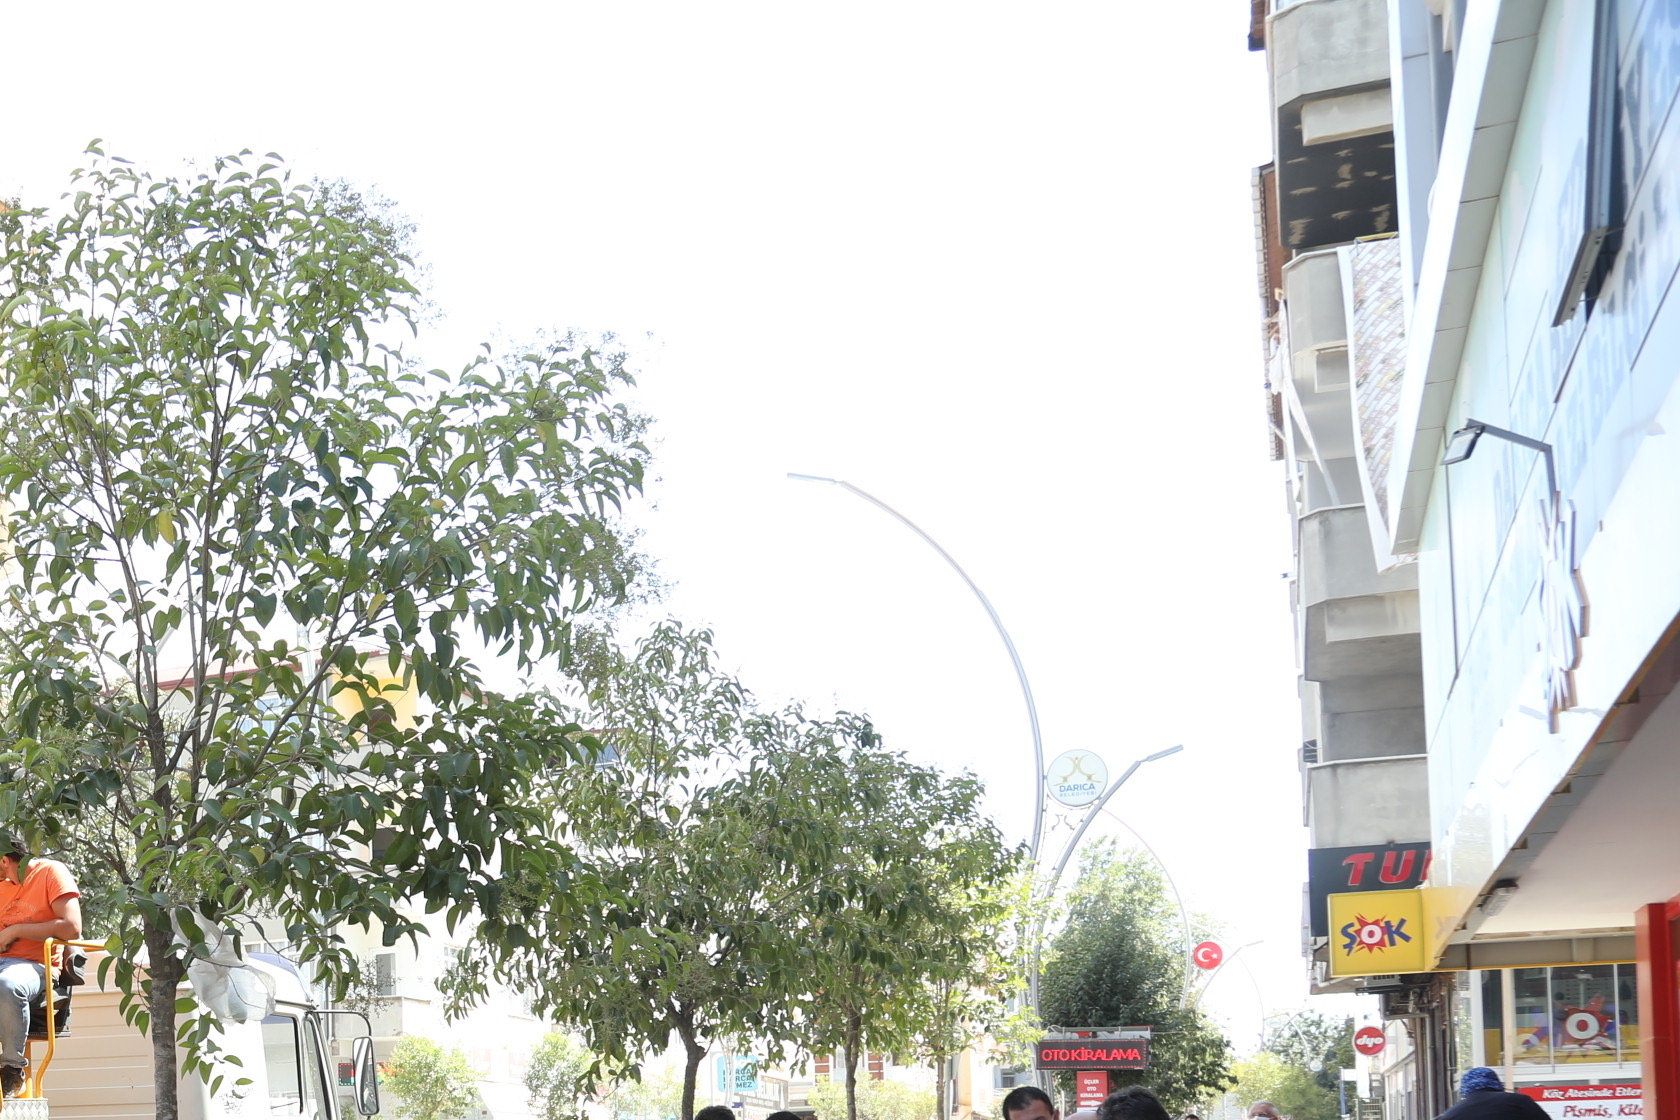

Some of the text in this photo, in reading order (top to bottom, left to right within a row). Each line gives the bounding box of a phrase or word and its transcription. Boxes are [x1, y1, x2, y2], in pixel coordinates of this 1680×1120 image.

[1060, 783, 1095, 792] DARICA
[1341, 918, 1412, 956] ŞOK
[1356, 1035, 1383, 1048] dyo
